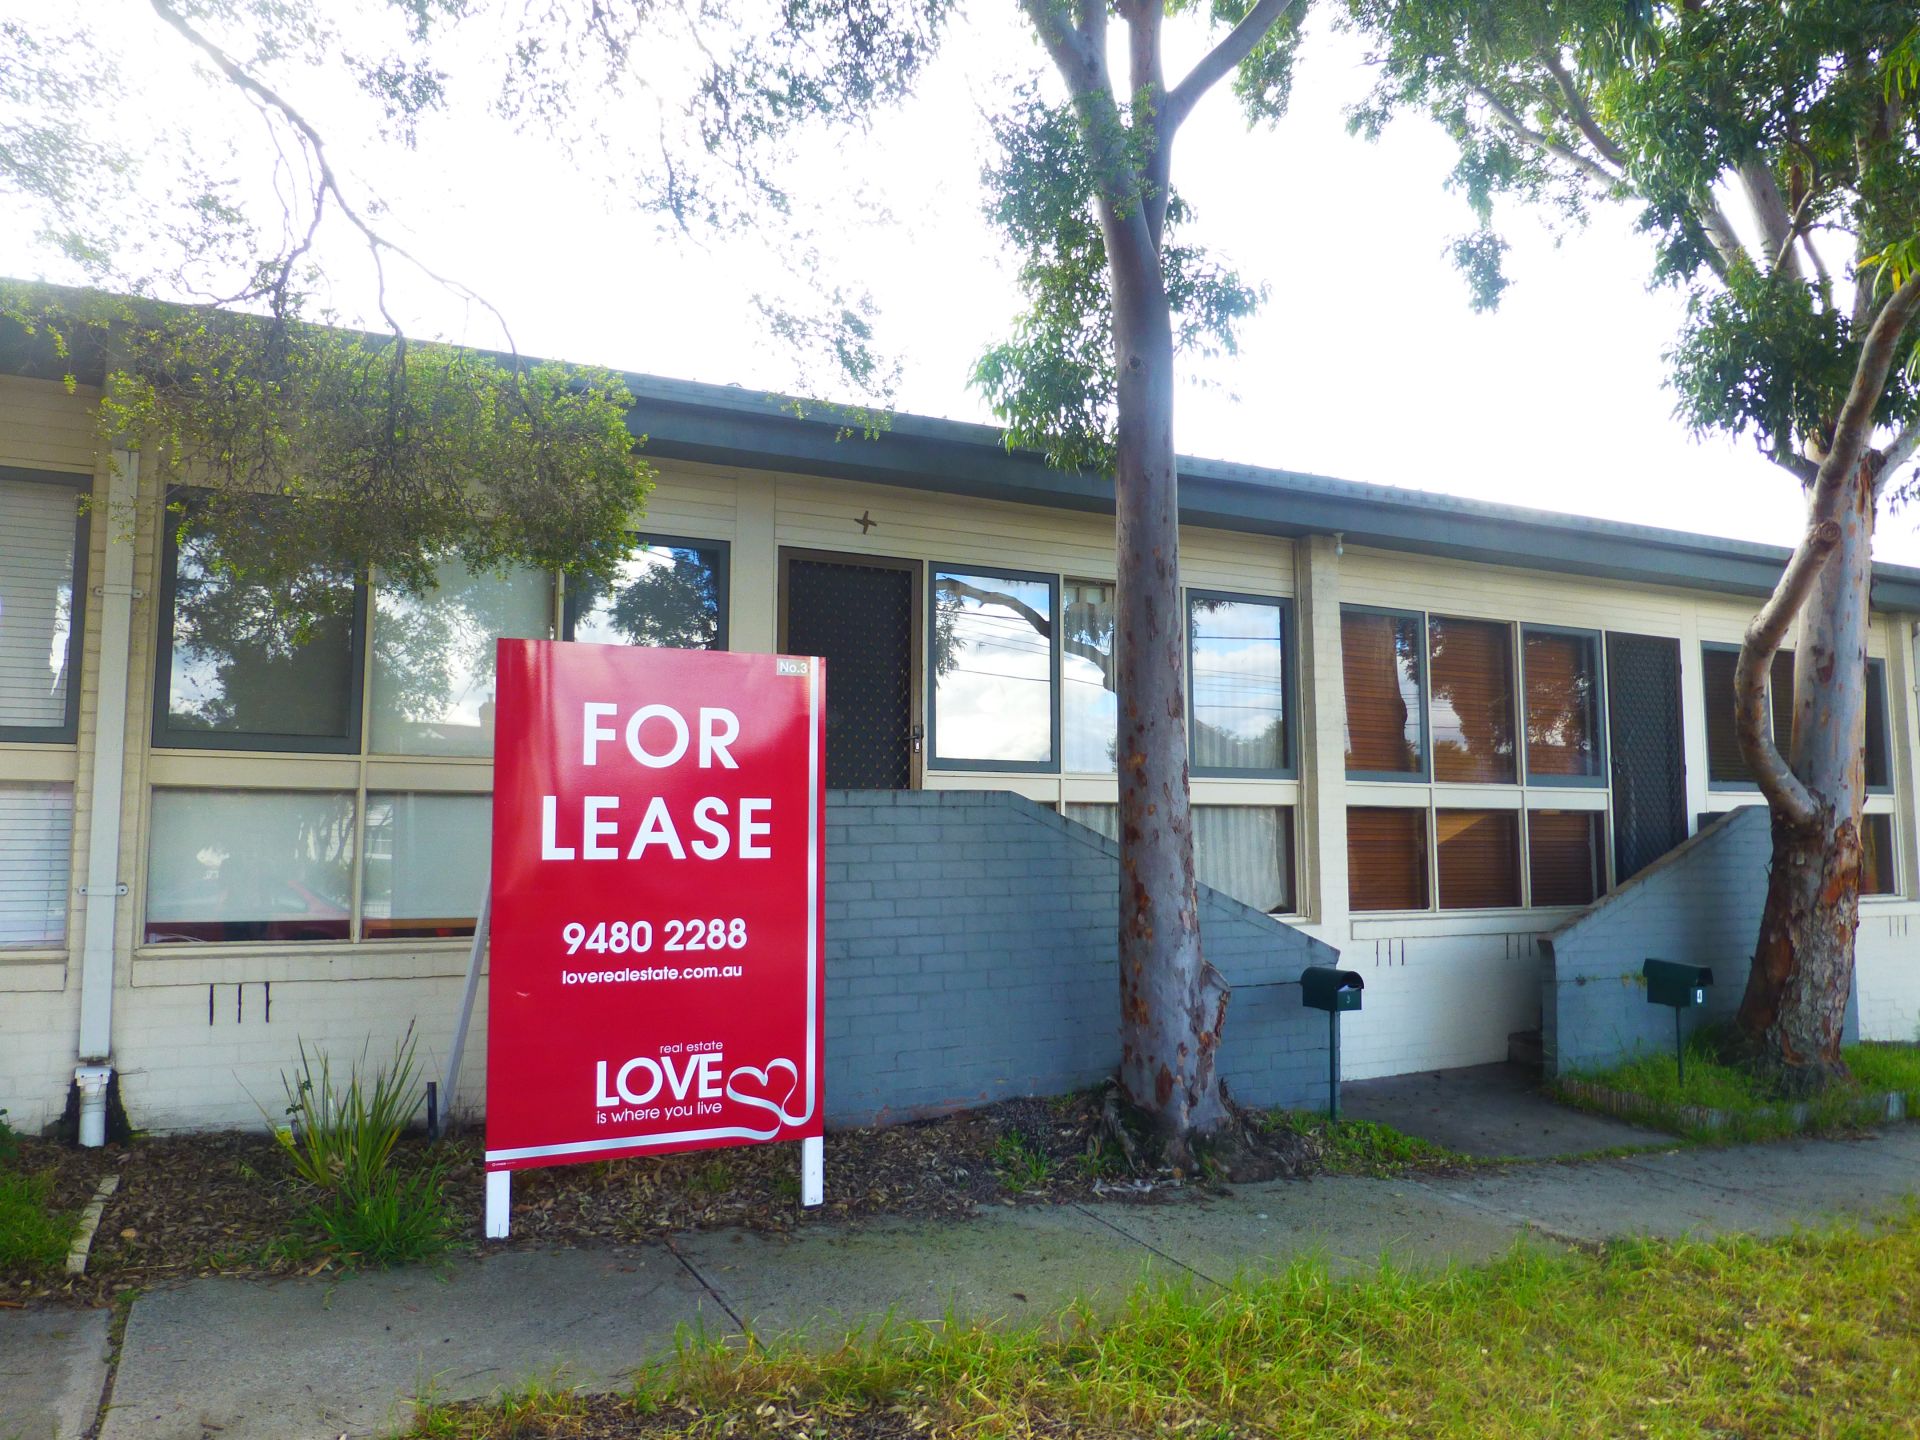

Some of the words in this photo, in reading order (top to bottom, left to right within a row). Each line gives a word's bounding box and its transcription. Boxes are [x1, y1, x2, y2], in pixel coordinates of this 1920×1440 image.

[779, 661, 808, 674] No.3
[583, 701, 740, 769] FOR
[541, 796, 772, 860] LEASE
[562, 920, 653, 955] 9480
[664, 918, 748, 952] 2288
[562, 964, 743, 985] loverealestate.com.au
[660, 1042, 683, 1054] real
[686, 1040, 724, 1053] estate
[596, 1052, 723, 1108] LOVE
[596, 1110, 607, 1124] is
[611, 1107, 661, 1123] where
[664, 1105, 693, 1121] you
[697, 1101, 723, 1115] live
